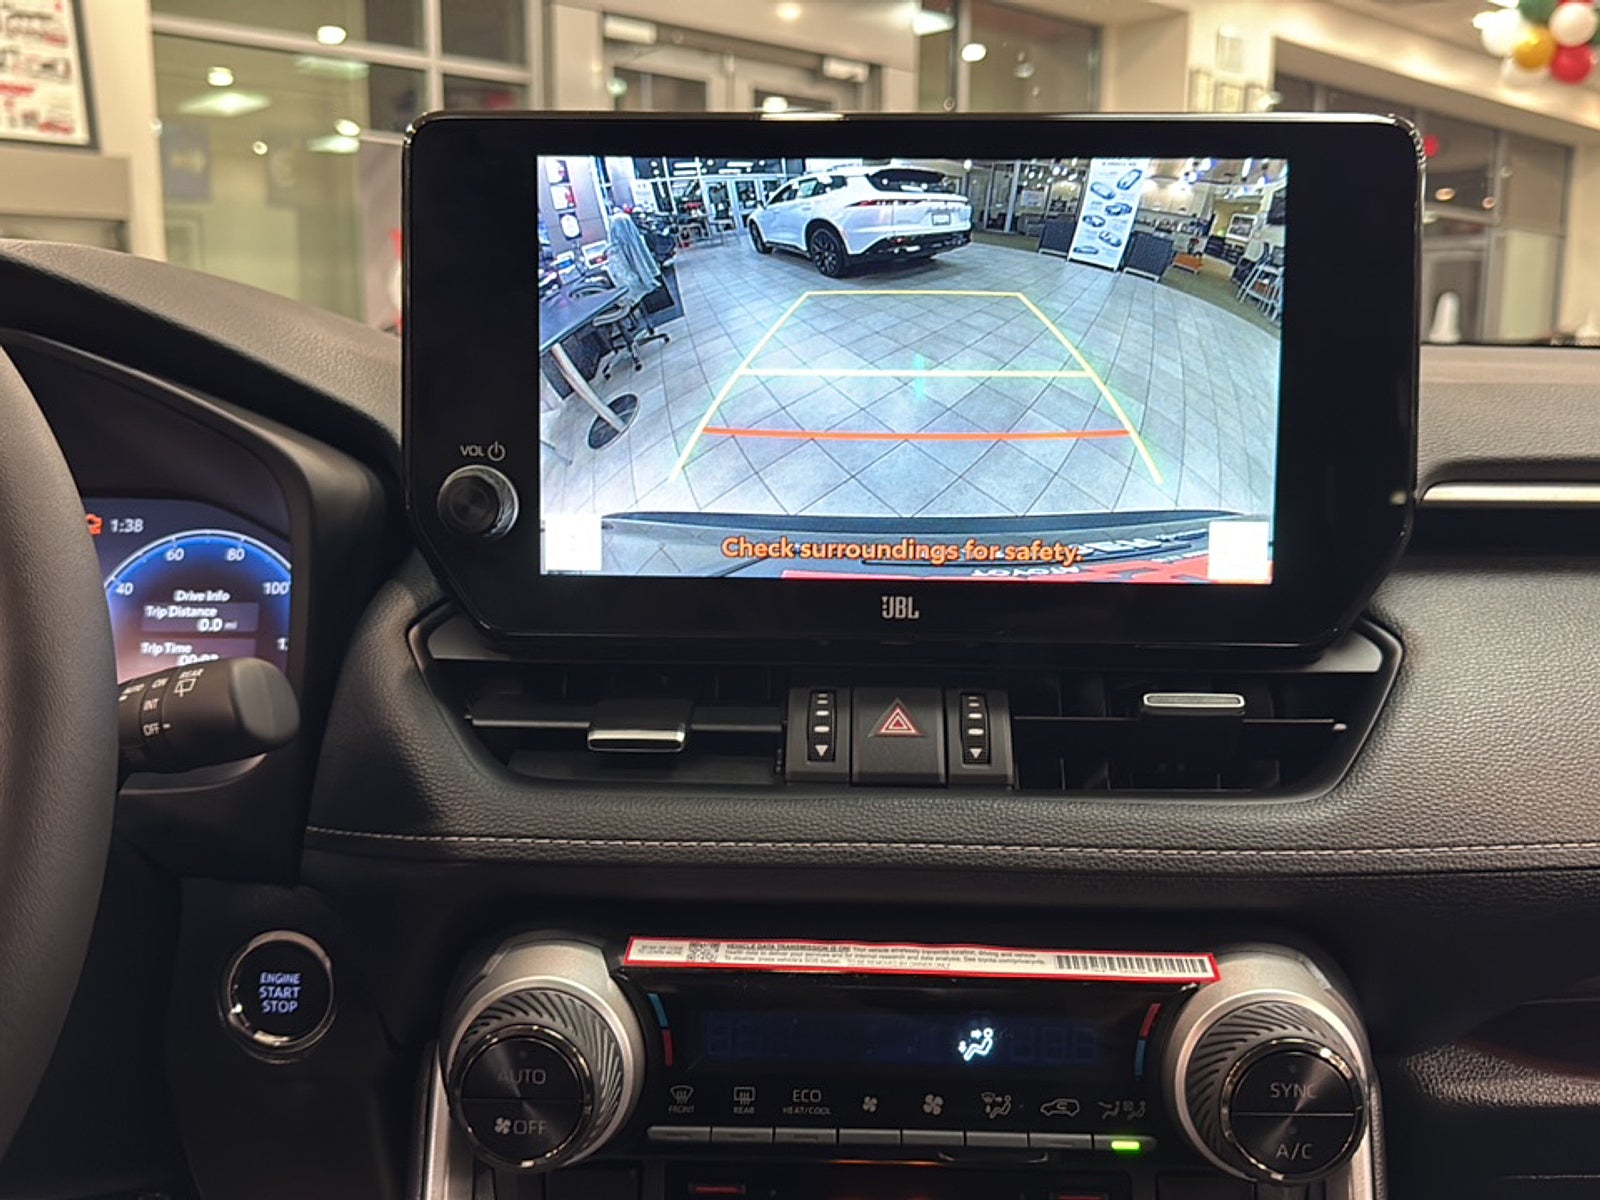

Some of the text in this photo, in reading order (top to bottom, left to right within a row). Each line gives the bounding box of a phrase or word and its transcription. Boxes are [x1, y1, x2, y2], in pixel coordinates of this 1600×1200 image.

[460, 445, 485, 457] VOL
[110, 518, 144, 533] 1:38
[166, 548, 184, 561] 60
[226, 548, 245, 561] 80
[721, 535, 795, 559] Check
[799, 537, 960, 566] surroundings
[963, 538, 1000, 560] for
[1003, 538, 1084, 567] safety.
[116, 582, 133, 596] 40
[174, 589, 230, 602] Drive Info
[263, 582, 289, 595] 100
[144, 605, 218, 620] Trip Distance
[881, 595, 920, 619] JBL
[197, 618, 238, 632] 0.0 mi
[140, 642, 192, 657] Trip Time
[143, 722, 160, 736] OFF
[260, 972, 301, 984] ENGINE
[259, 986, 301, 999] START
[262, 1000, 298, 1013] STOP
[498, 1067, 547, 1085] AUTO
[792, 1089, 822, 1103] ECO
[1269, 1082, 1318, 1099] SYNC
[668, 1105, 695, 1114] FRONT
[733, 1106, 755, 1114] REAR
[782, 1106, 831, 1115] HEAT/COOL
[513, 1119, 548, 1135] OFF
[1275, 1143, 1313, 1160] A/C
